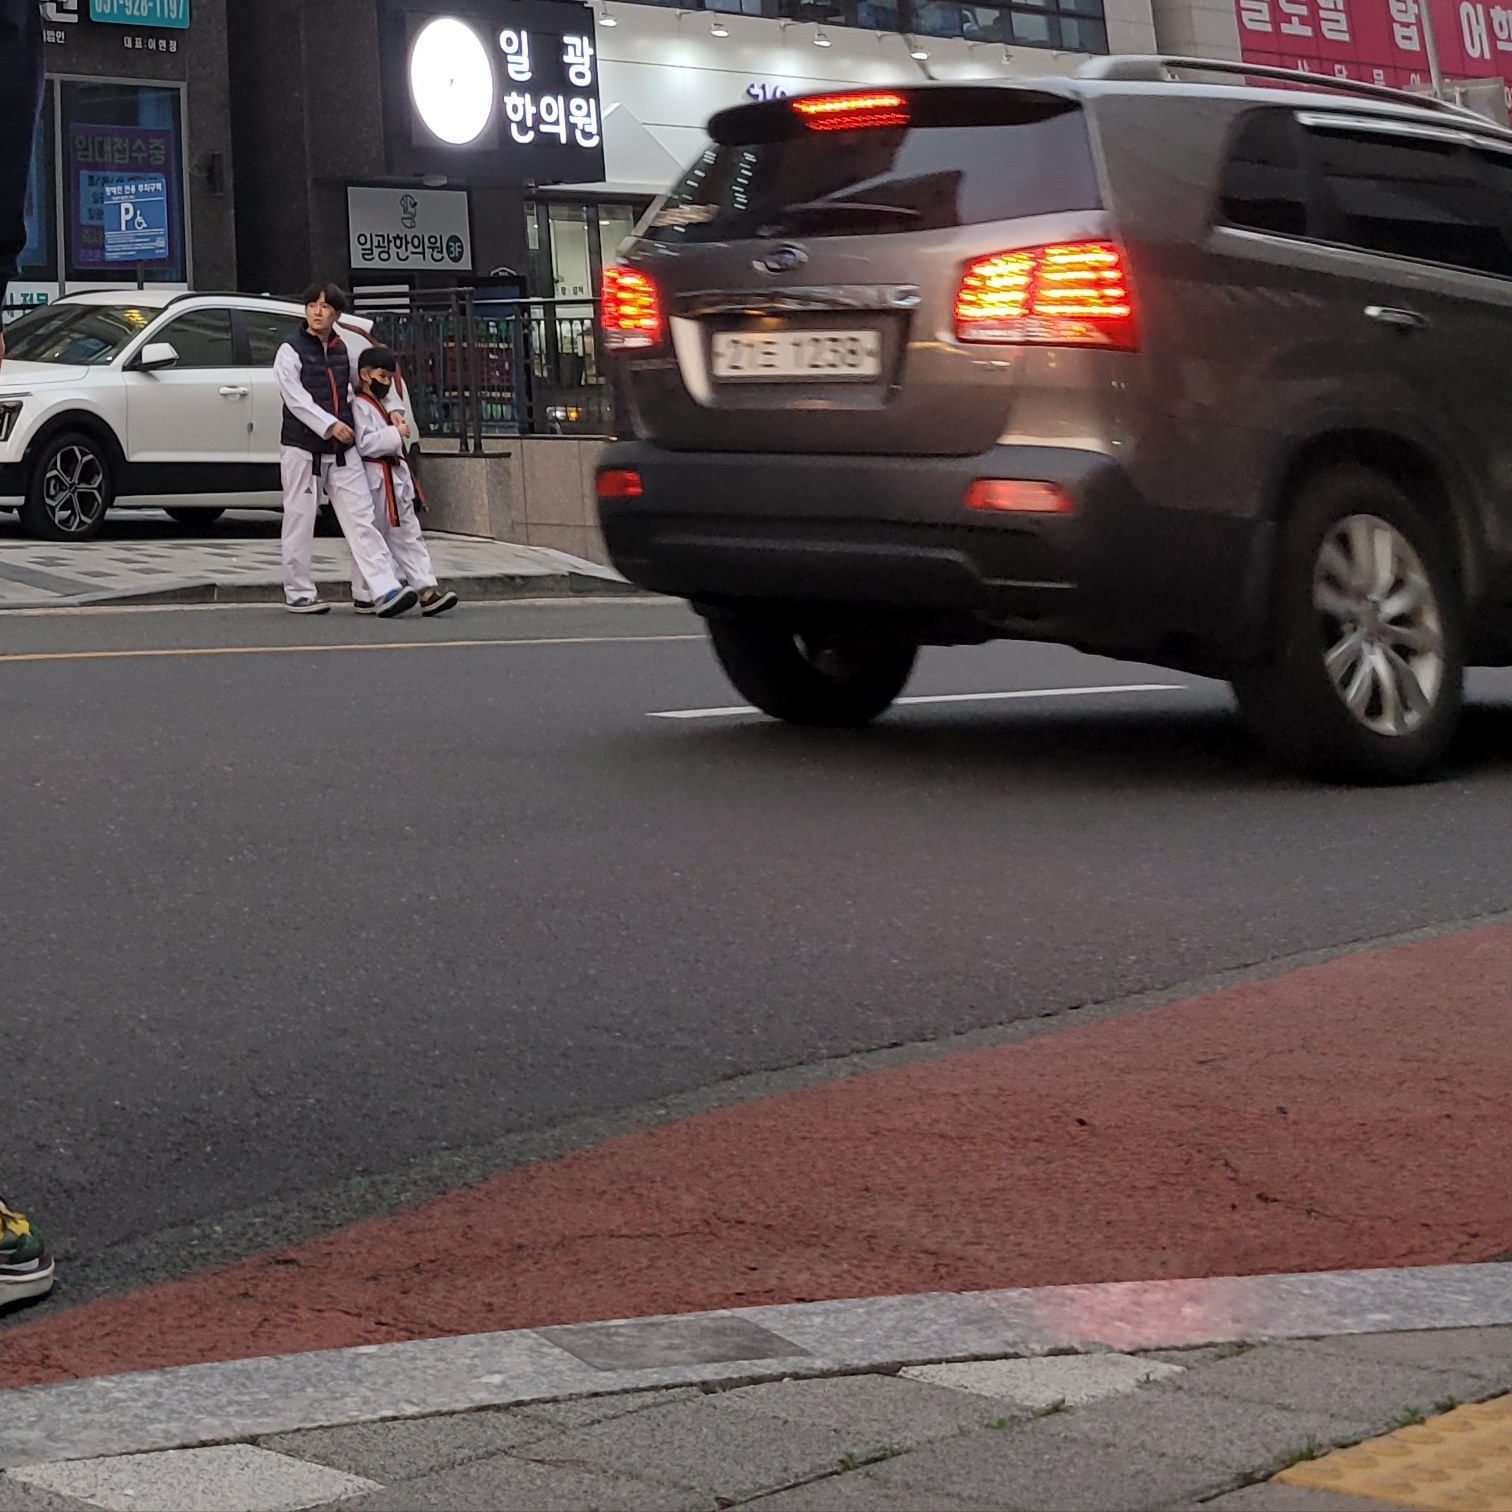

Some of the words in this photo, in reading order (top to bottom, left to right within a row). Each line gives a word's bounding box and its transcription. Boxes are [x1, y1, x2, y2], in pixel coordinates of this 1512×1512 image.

[502, 91, 601, 149] 한의원
[120, 202, 135, 232] P
[355, 232, 445, 263] 일광한의원
